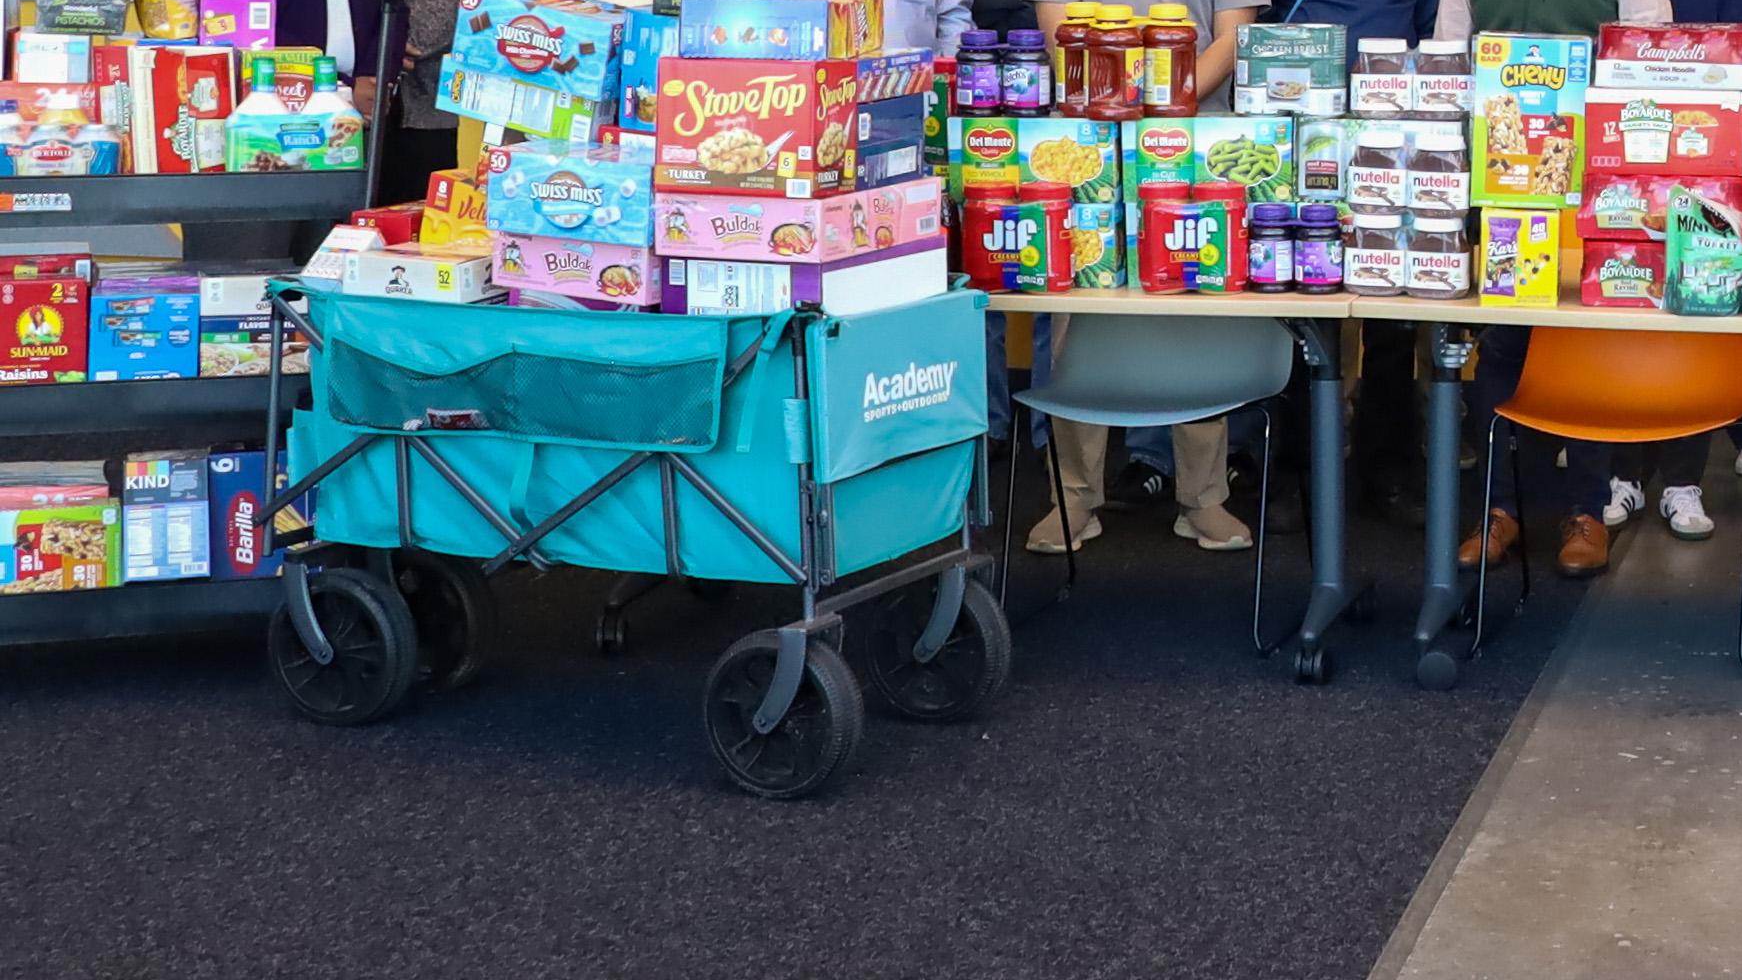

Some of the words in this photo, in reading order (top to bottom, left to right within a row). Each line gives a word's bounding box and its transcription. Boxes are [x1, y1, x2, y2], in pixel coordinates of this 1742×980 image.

[495, 23, 533, 44] SWISS
[532, 32, 563, 56] MISS
[1251, 44, 1293, 54] CHICKEN
[1293, 43, 1329, 54] BREAST
[1480, 42, 1503, 56] 60
[1636, 42, 1705, 63] Campbell's
[1359, 78, 1408, 90] nutella
[1420, 77, 1468, 90] nutella
[1620, 108, 1673, 122] BOYARDEE
[1603, 121, 1616, 136] 12
[283, 134, 321, 147] Ranch
[490, 154, 508, 169] 50
[782, 156, 790, 167] 6
[668, 169, 708, 181] TURKEY
[1353, 171, 1400, 184] nutella
[1412, 176, 1461, 189] nutella
[530, 182, 569, 200] SWISS
[570, 186, 604, 206] MISS
[1595, 194, 1648, 211] BOYARDEE
[709, 216, 762, 238] Buldak
[1164, 216, 1219, 252] Jif
[1532, 222, 1546, 235] 40
[982, 218, 1038, 252] Jif
[543, 252, 593, 273] Buldak
[1352, 252, 1400, 266] nutella
[1412, 256, 1461, 269] nutella
[438, 270, 451, 285] 52
[1600, 266, 1653, 281] BOYARDEE
[863, 361, 955, 409] Academy
[125, 475, 170, 490] KIND
[236, 500, 254, 565] Barilla
